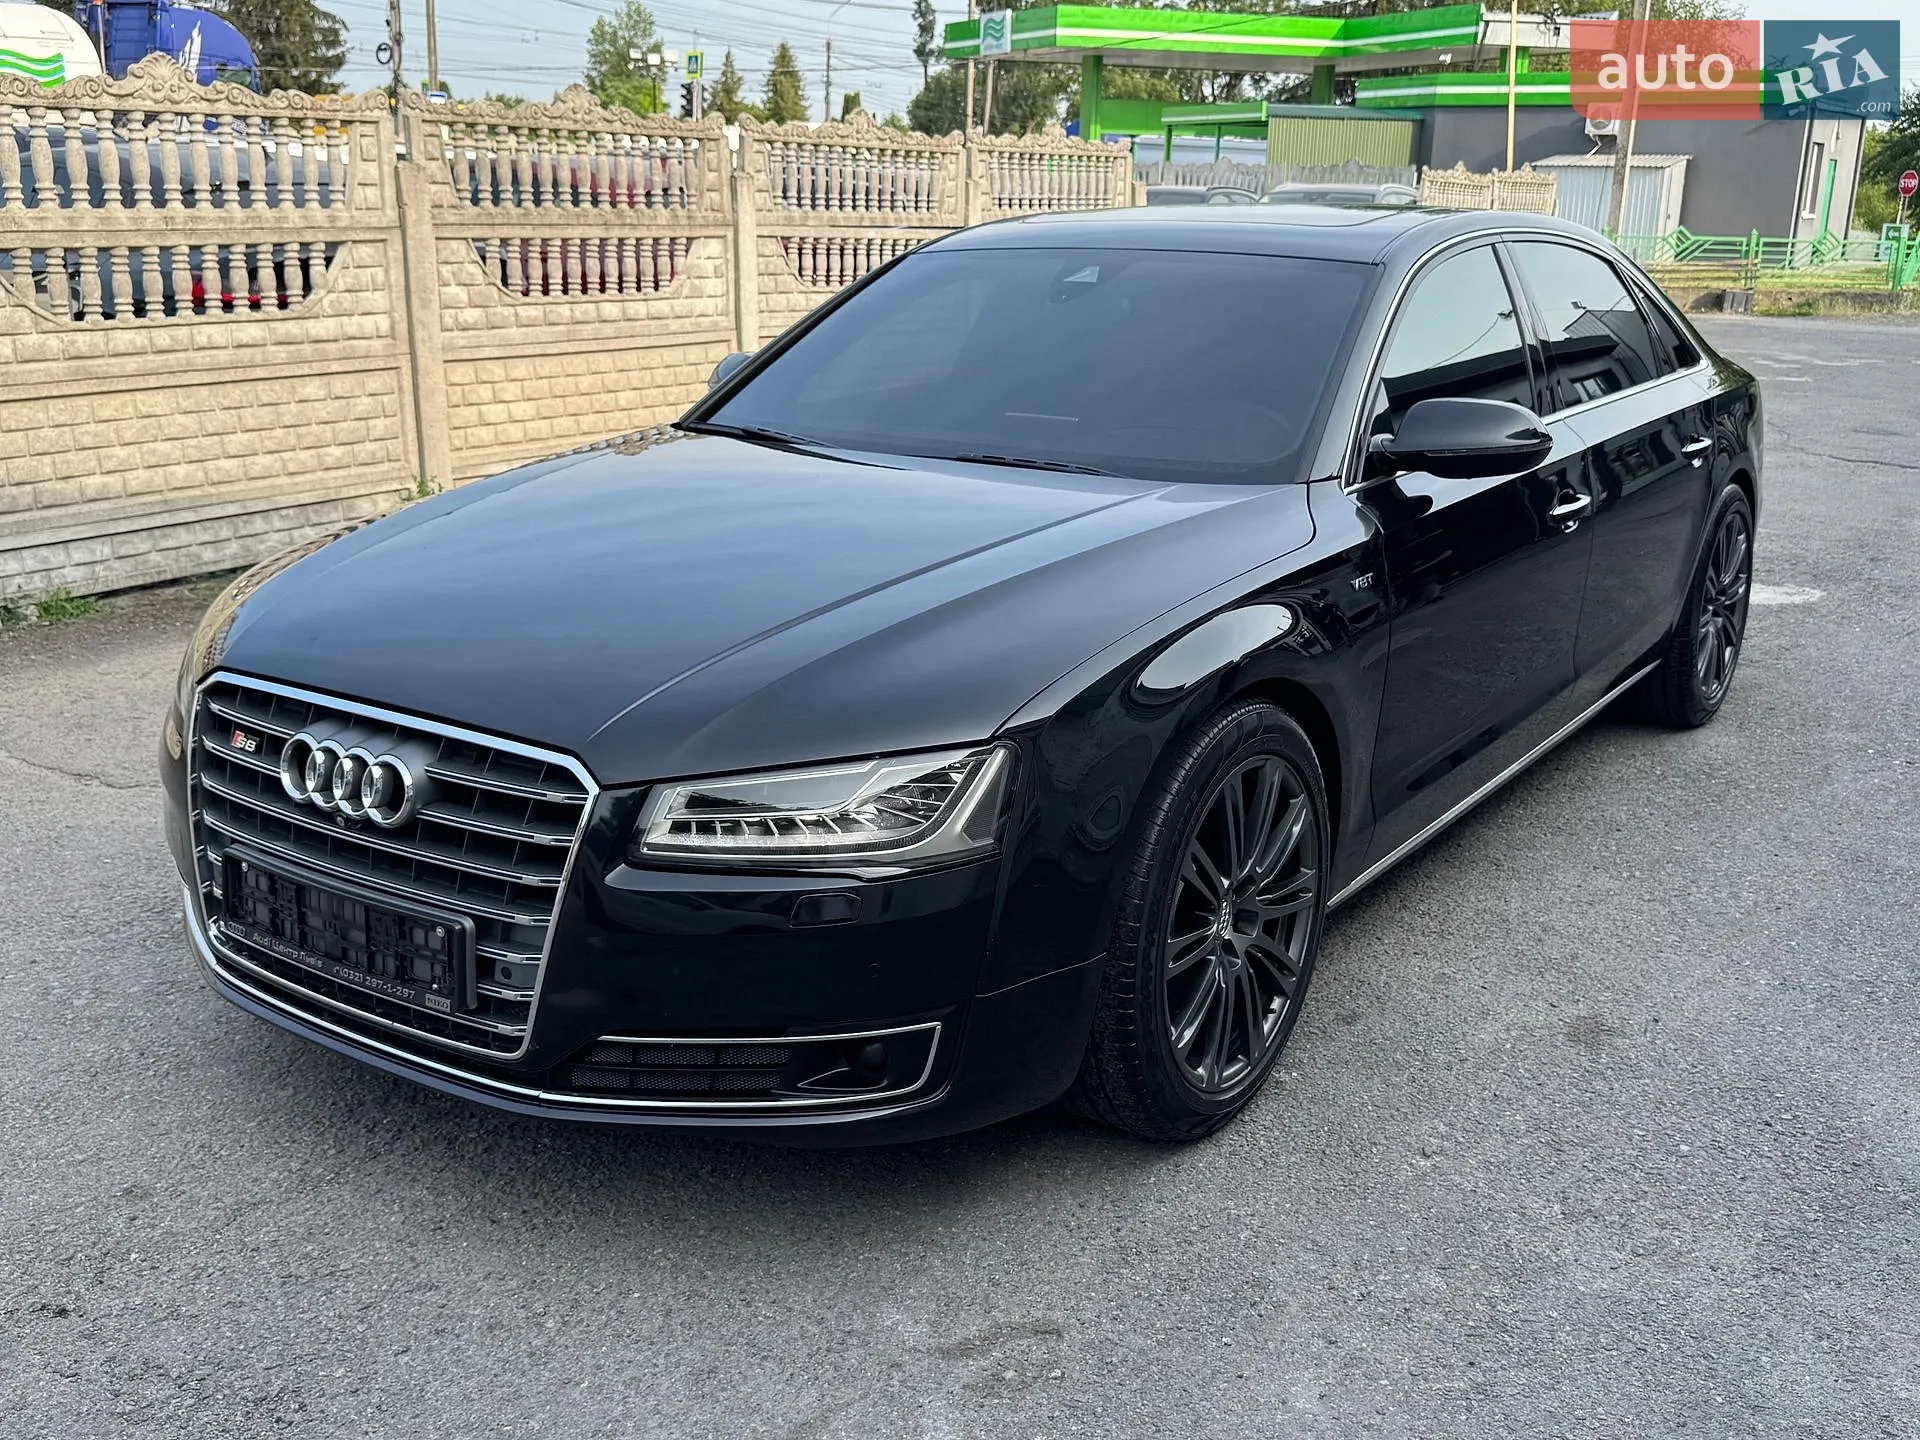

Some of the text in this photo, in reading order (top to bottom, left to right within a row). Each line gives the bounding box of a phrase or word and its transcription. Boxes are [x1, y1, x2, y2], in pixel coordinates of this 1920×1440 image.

[1900, 178, 1917, 188] STOP
[1350, 572, 1374, 591] V8T
[252, 932, 272, 947] Audi
[365, 975, 416, 999] 297-1-297
